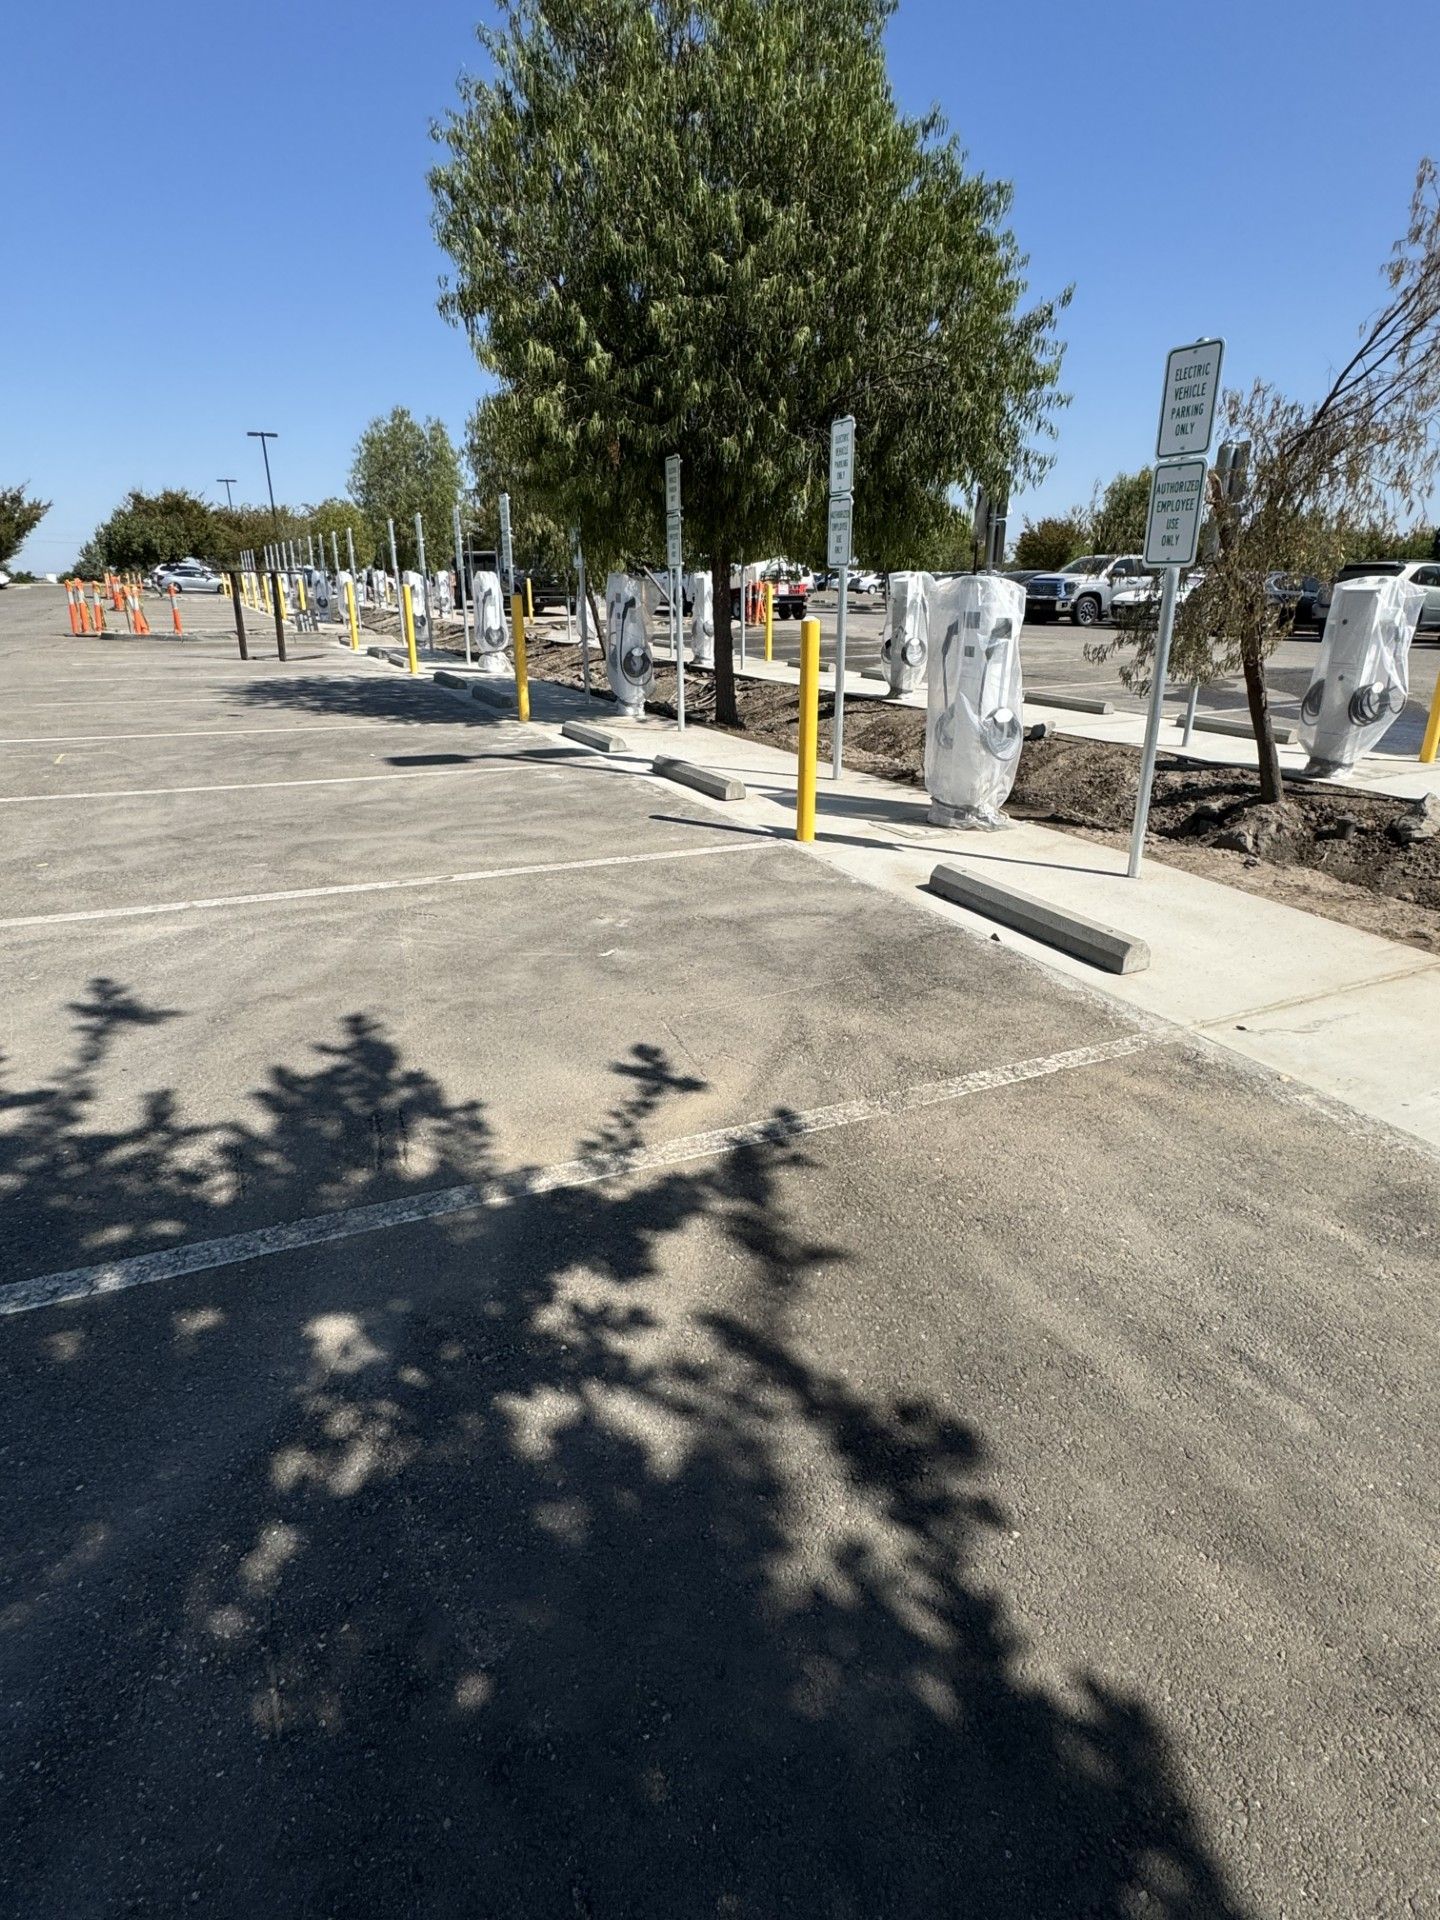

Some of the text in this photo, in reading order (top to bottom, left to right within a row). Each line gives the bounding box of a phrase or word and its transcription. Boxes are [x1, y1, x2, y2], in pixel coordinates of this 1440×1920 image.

[1175, 362, 1211, 382] ELECTRIC
[1174, 382, 1207, 401] VEHICLE
[1171, 402, 1204, 420] PARKING
[1175, 422, 1195, 436] ONLY
[1156, 479, 1200, 494] AUTHORIZED
[1156, 497, 1195, 513] EMPLOYEE
[1166, 517, 1180, 530] USE
[1161, 534, 1180, 546] ONLY
